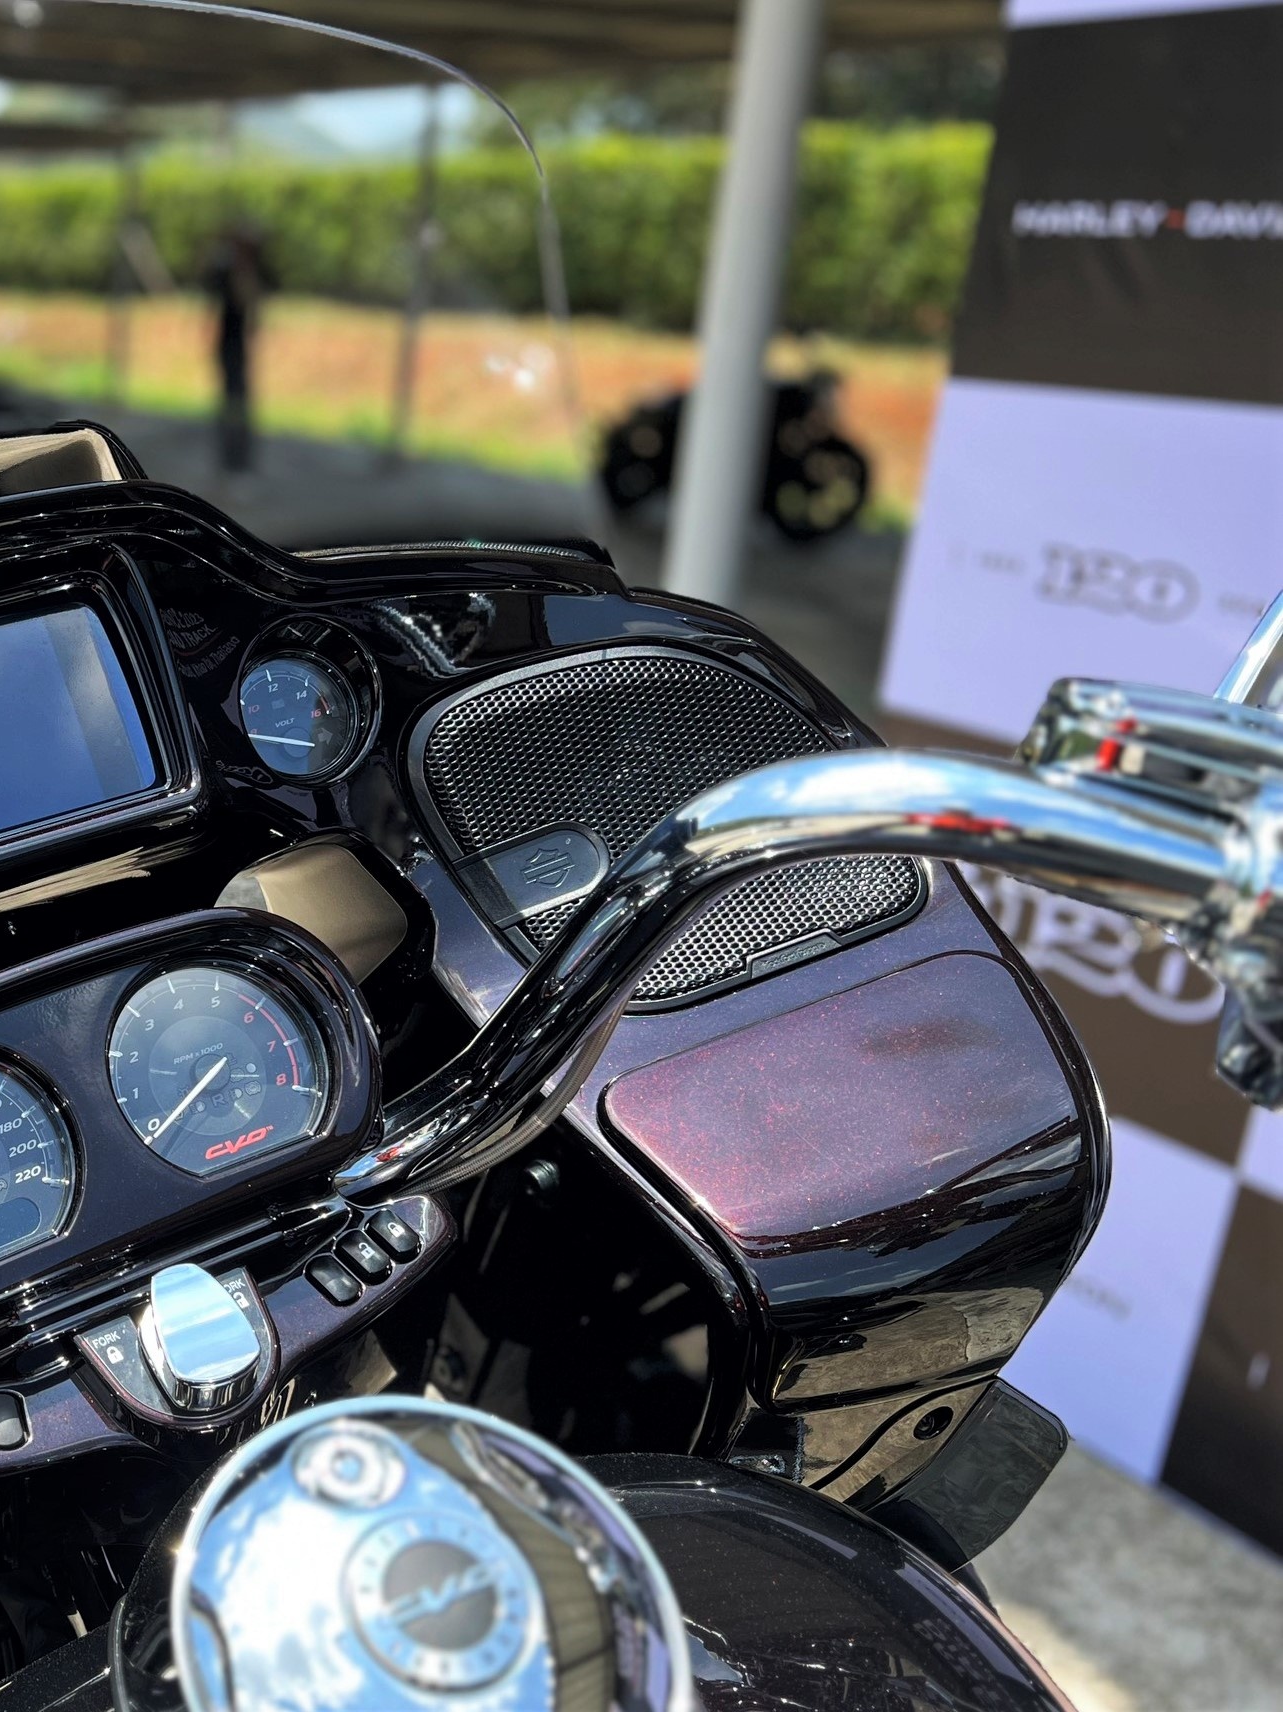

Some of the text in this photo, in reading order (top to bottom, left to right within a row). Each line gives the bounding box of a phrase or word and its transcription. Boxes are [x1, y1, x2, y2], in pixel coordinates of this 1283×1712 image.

[268, 683, 278, 693] 12
[296, 690, 307, 700] 14
[248, 705, 259, 715] 10
[311, 709, 322, 718] 16
[275, 718, 295, 728] VOLT
[174, 999, 184, 1010] 4
[211, 996, 220, 1008] 5
[244, 1012, 254, 1023] 6
[145, 1019, 154, 1031] 3
[267, 1040, 276, 1052] 7
[130, 1051, 138, 1063] 2
[174, 1052, 193, 1064] RPM
[200, 1043, 223, 1055] 1000
[276, 1073, 286, 1086] 8
[133, 1088, 139, 1099] 1
[148, 1118, 160, 1131] 0
[9, 1139, 37, 1158] 200
[15, 1165, 41, 1183] 220
[223, 1278, 246, 1293] ORK
[93, 1331, 120, 1349] FORK
